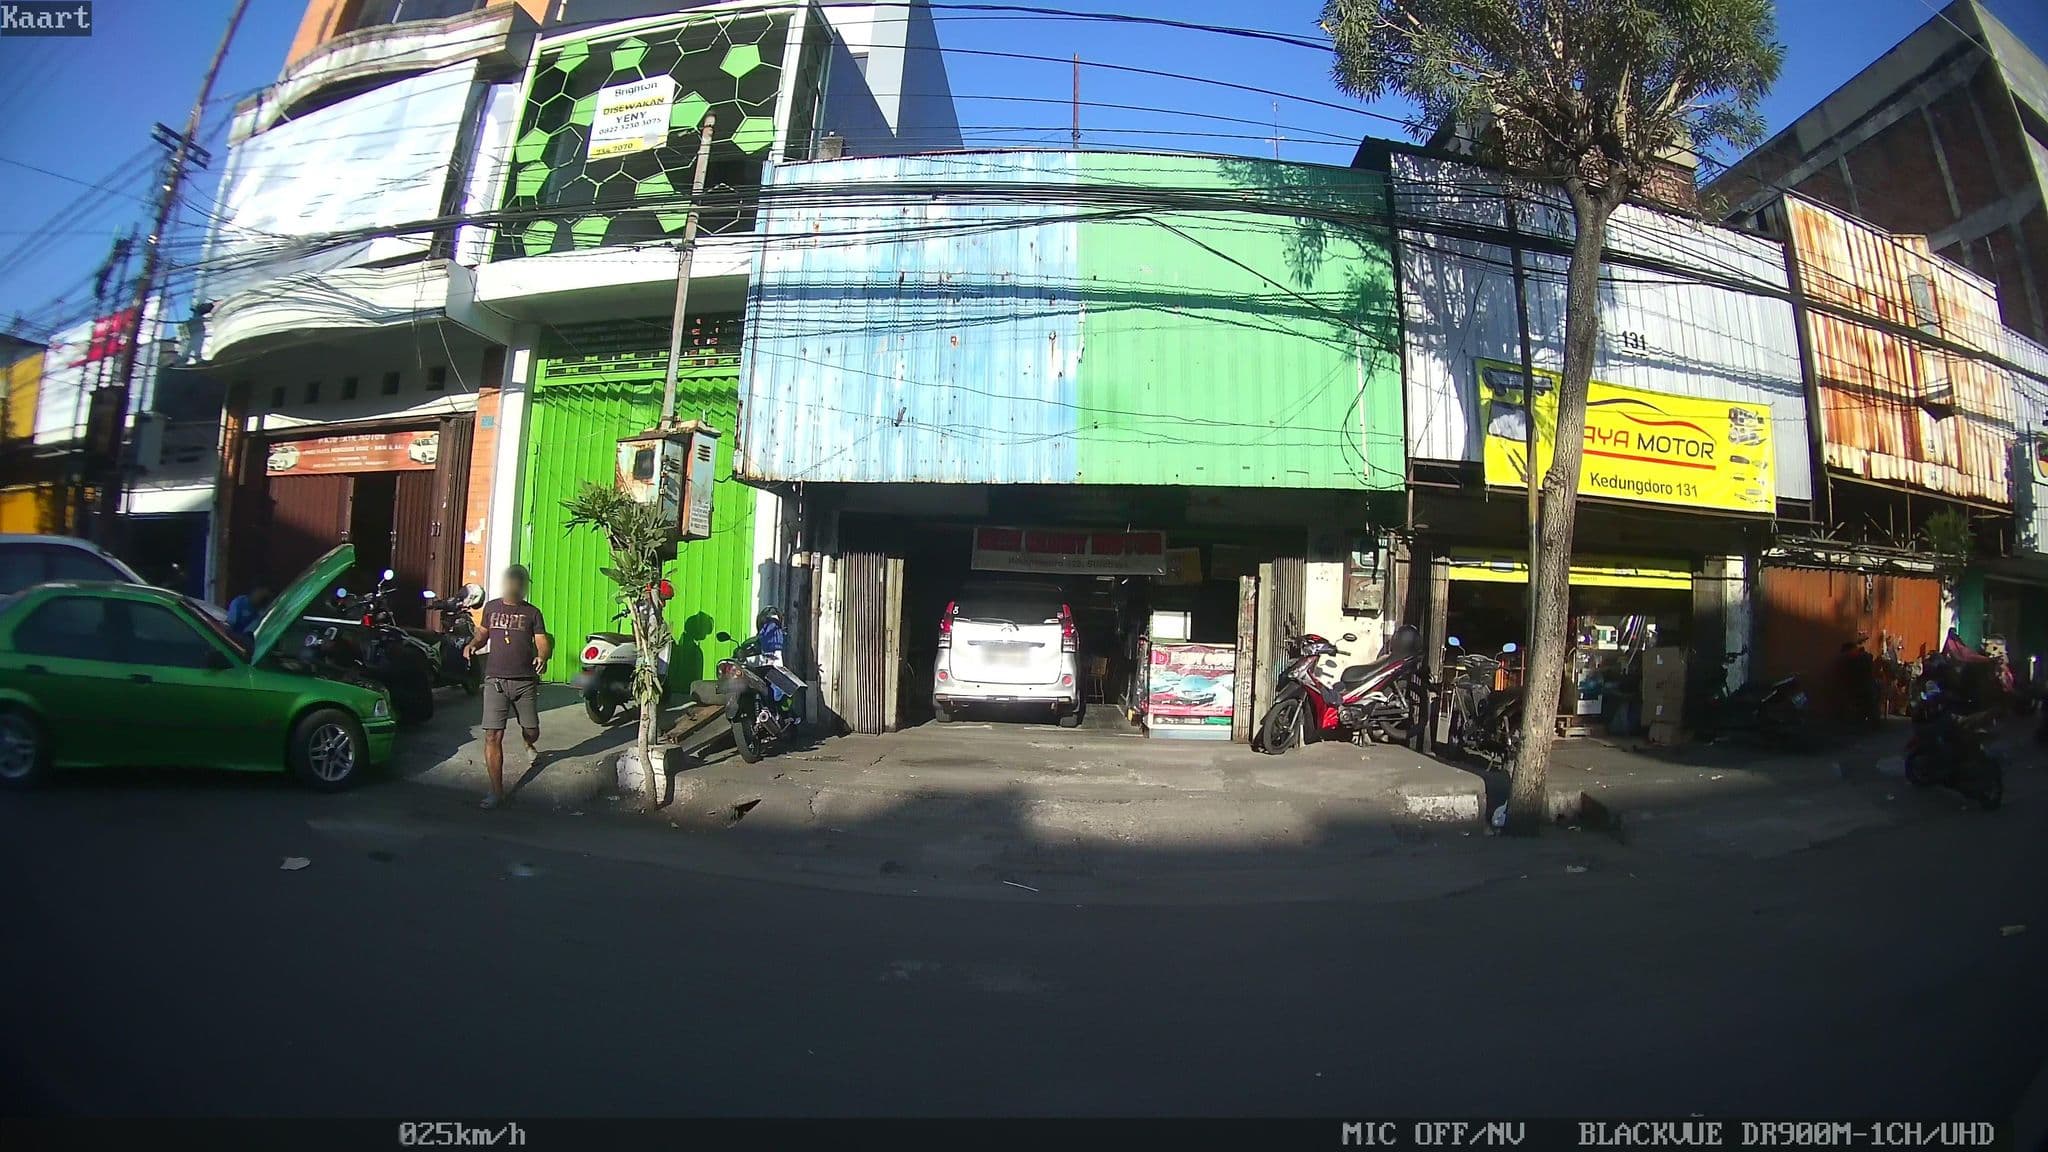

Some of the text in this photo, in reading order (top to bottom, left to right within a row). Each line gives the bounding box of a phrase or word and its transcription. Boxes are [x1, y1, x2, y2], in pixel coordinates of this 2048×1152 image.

[614, 82, 658, 97] Brighton
[603, 97, 665, 115] DISEWAKAN
[616, 111, 647, 123] YENY
[1622, 330, 1646, 350] 131
[1583, 425, 1714, 460] AYA MOTOR
[1590, 472, 1698, 498] Kedungdoro 131
[490, 612, 527, 631] HOPE
